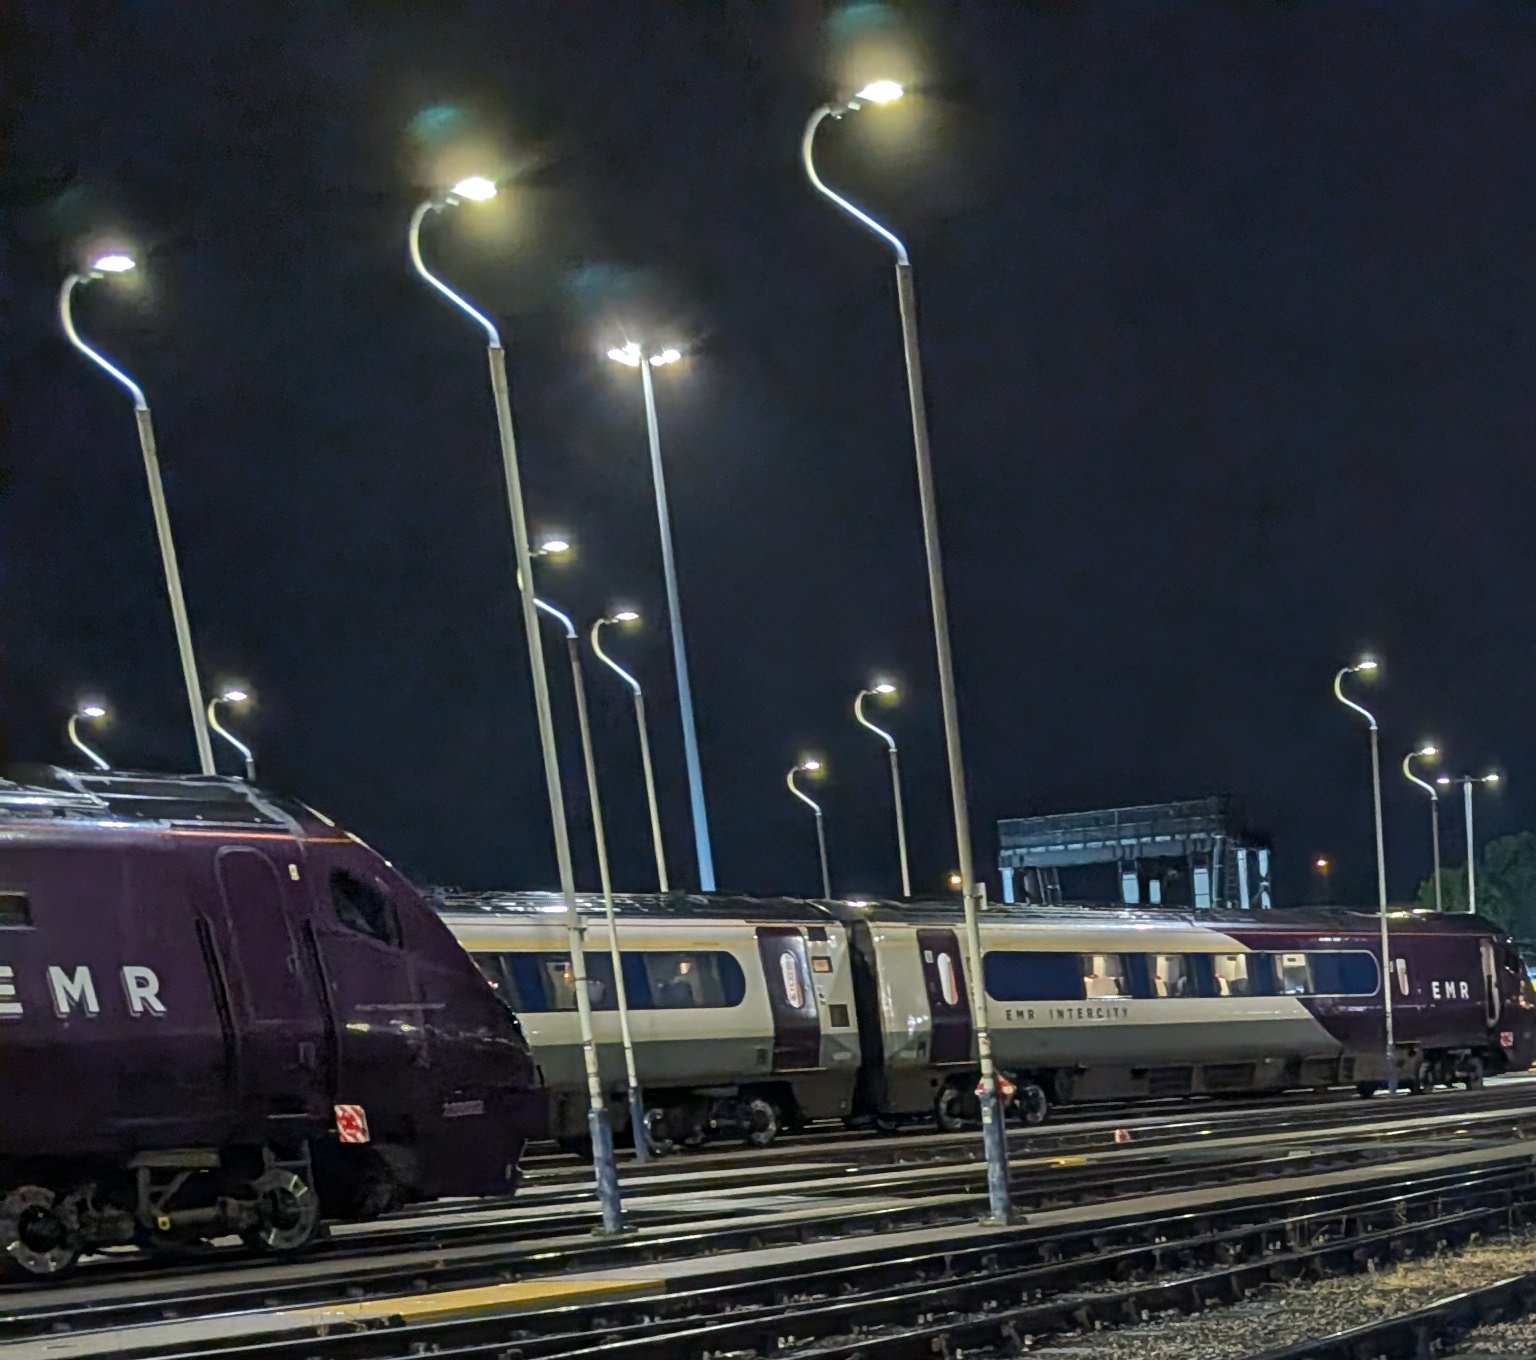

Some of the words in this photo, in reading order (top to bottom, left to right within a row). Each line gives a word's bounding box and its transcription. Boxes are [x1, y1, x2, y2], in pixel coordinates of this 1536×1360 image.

[1431, 981, 1470, 999] EMR
[1005, 1009, 1035, 1021] EMR
[1049, 1007, 1128, 1019] INTERCITY
